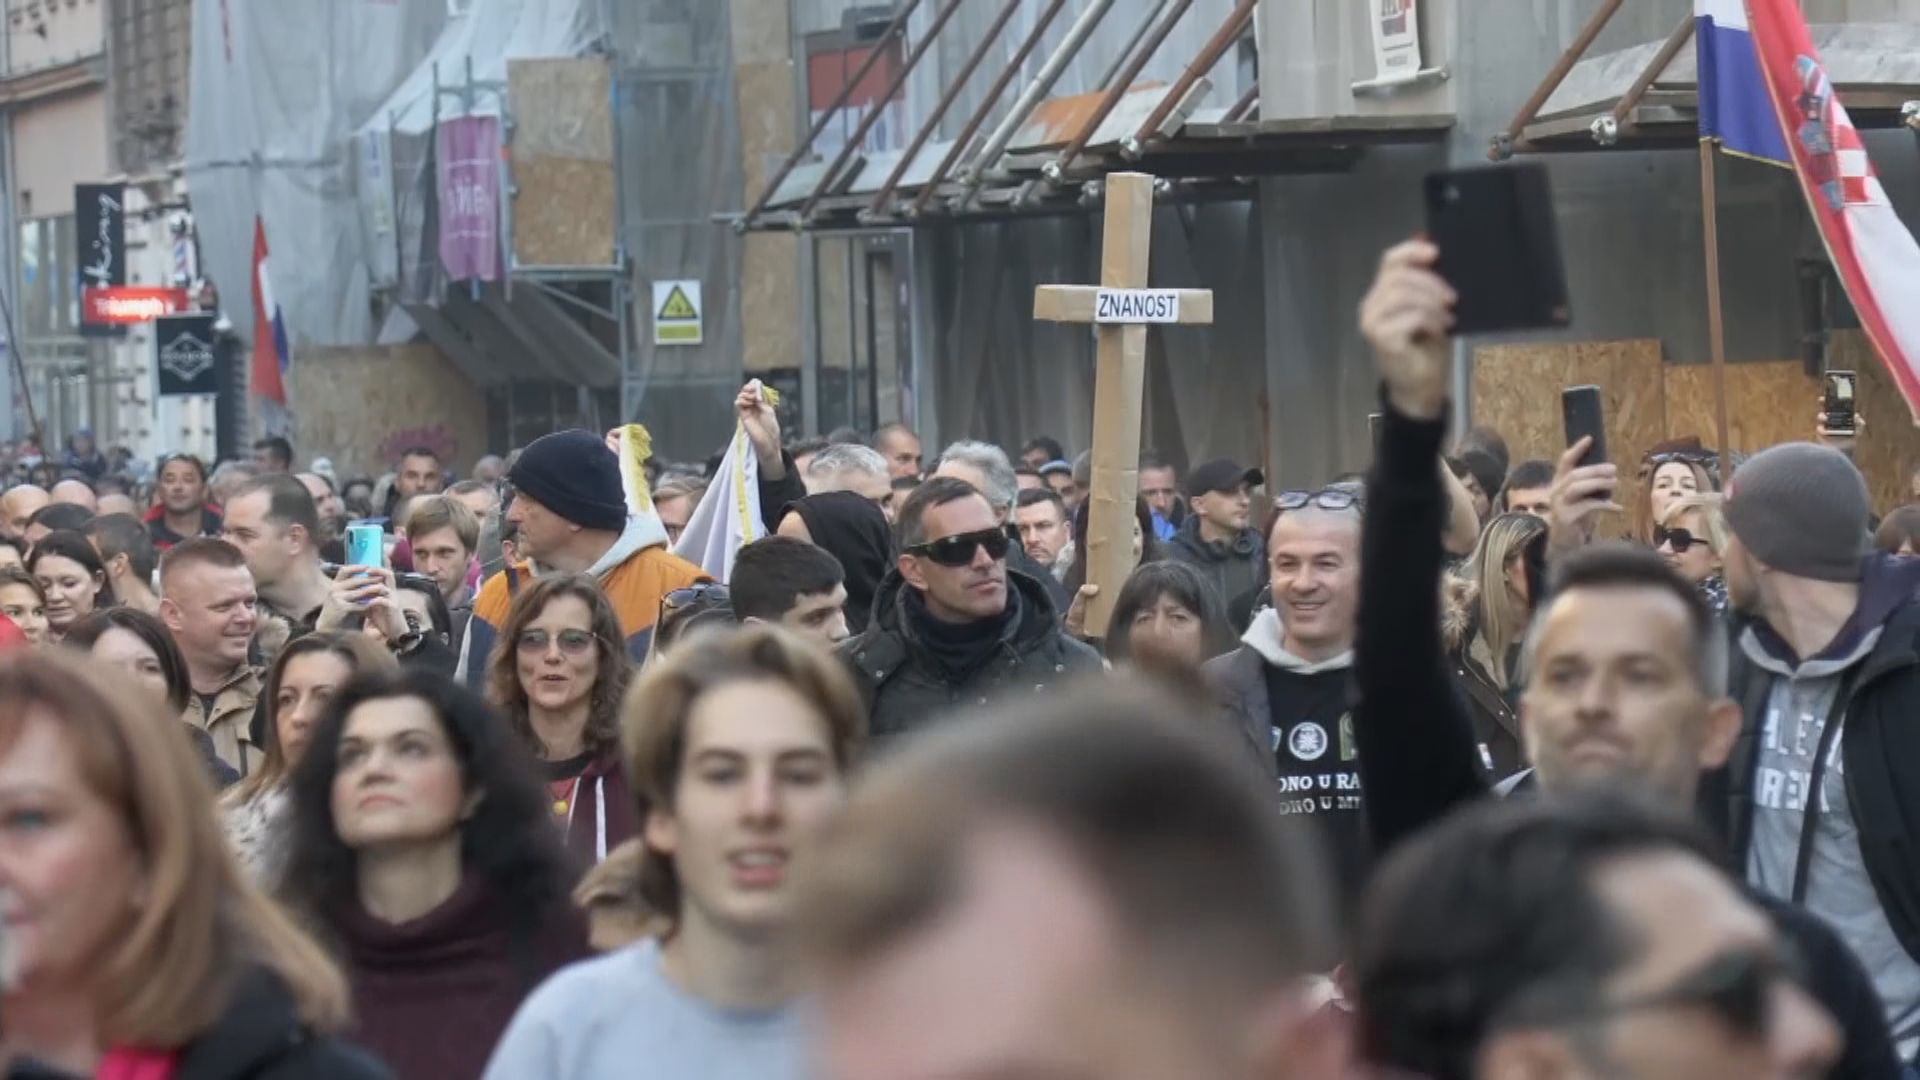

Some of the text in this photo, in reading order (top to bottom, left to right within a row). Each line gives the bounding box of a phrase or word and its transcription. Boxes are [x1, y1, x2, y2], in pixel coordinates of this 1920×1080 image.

[1098, 294, 1175, 318] ZNANOST
[1318, 774, 1331, 789] U
[1320, 796, 1333, 810] U
